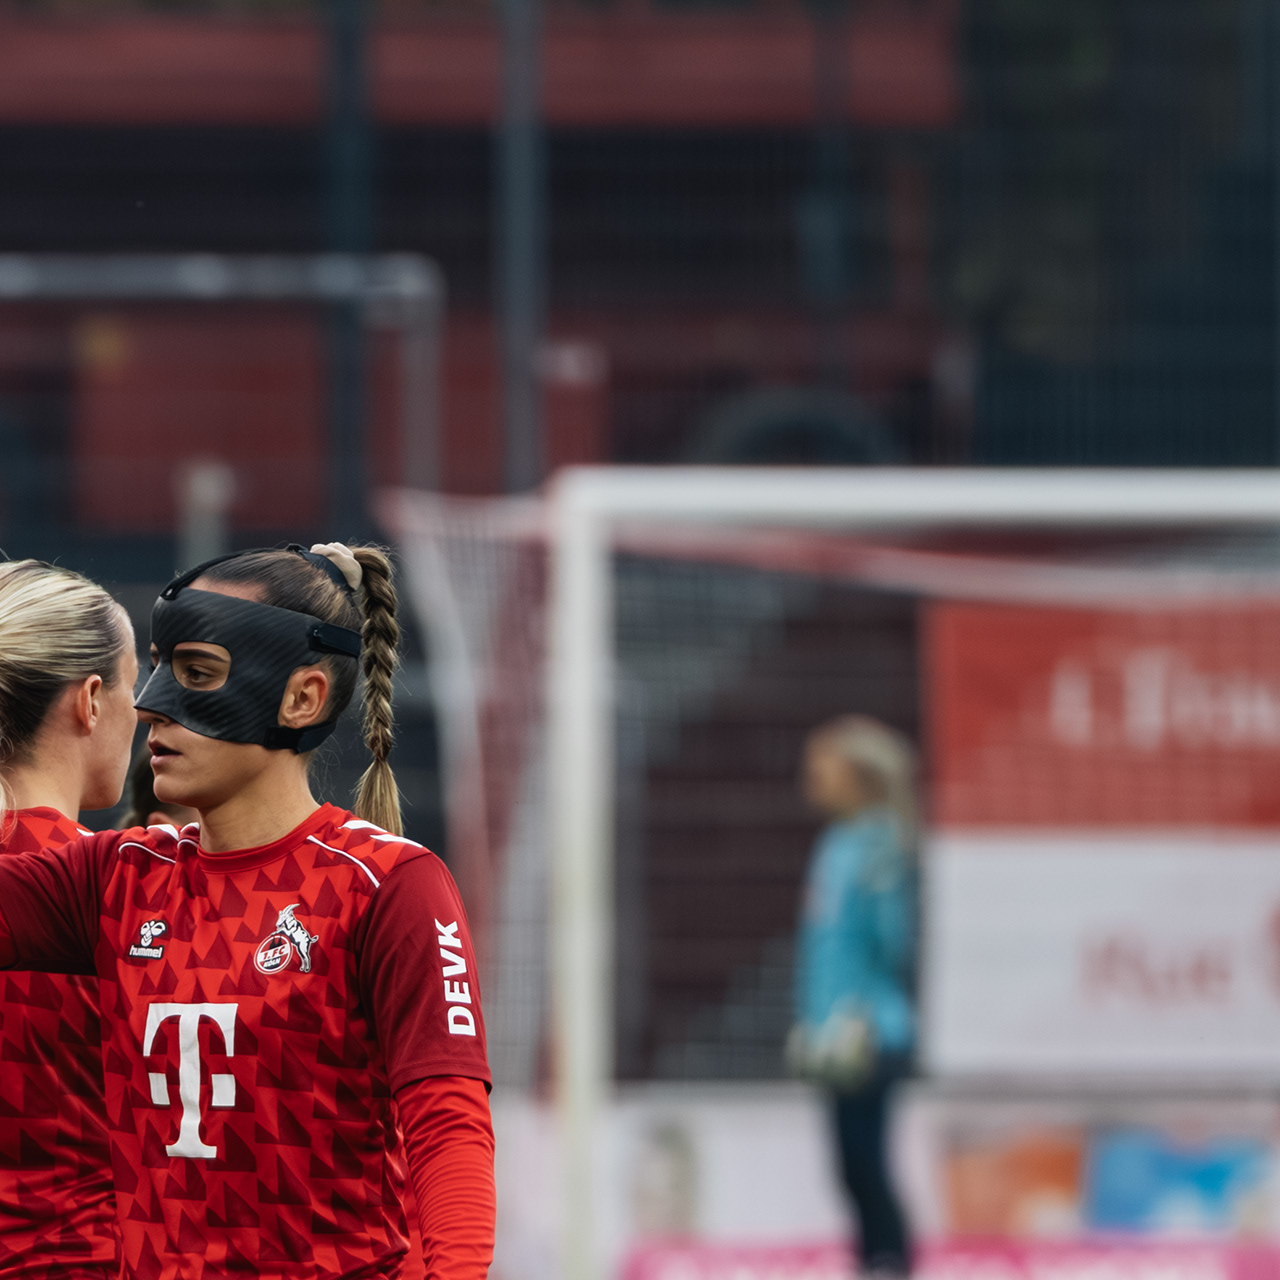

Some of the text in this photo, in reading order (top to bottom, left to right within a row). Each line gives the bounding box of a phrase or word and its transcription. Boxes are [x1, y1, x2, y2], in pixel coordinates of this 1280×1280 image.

[129, 945, 163, 958] hummel
[435, 918, 477, 1036] DEVK
[142, 1003, 238, 1158] T
